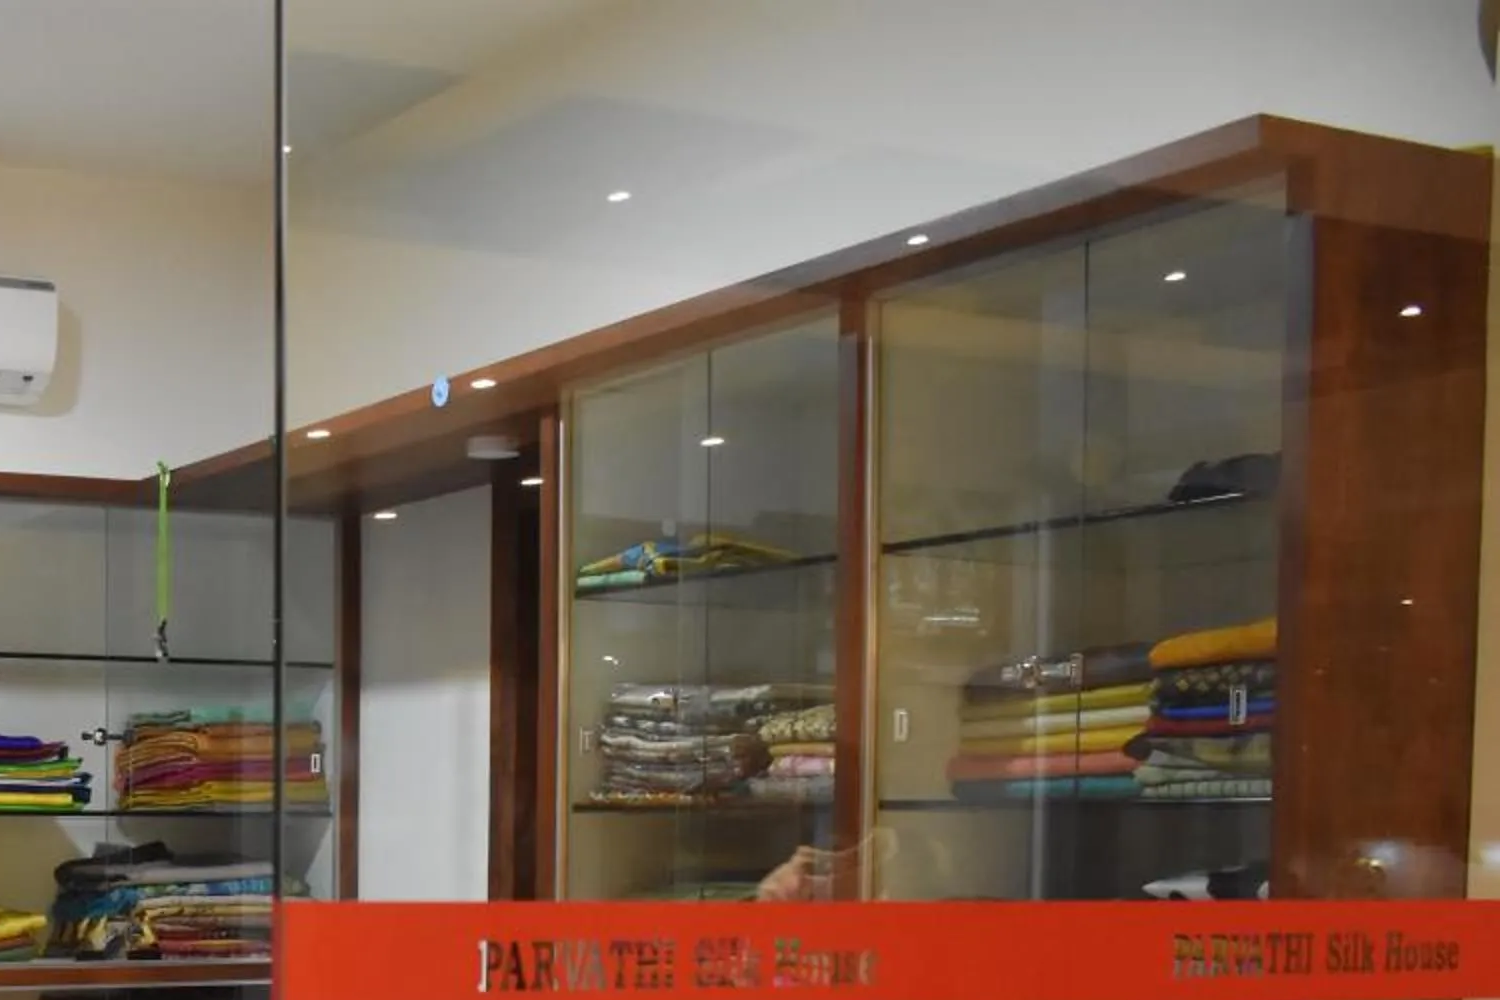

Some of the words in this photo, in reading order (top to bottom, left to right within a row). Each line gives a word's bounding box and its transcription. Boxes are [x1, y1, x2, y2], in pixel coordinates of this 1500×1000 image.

[477, 939, 677, 993] PARVATHI
[1172, 932, 1315, 980] PARVATHI
[1325, 931, 1375, 974] Silk
[1385, 930, 1461, 973] House
